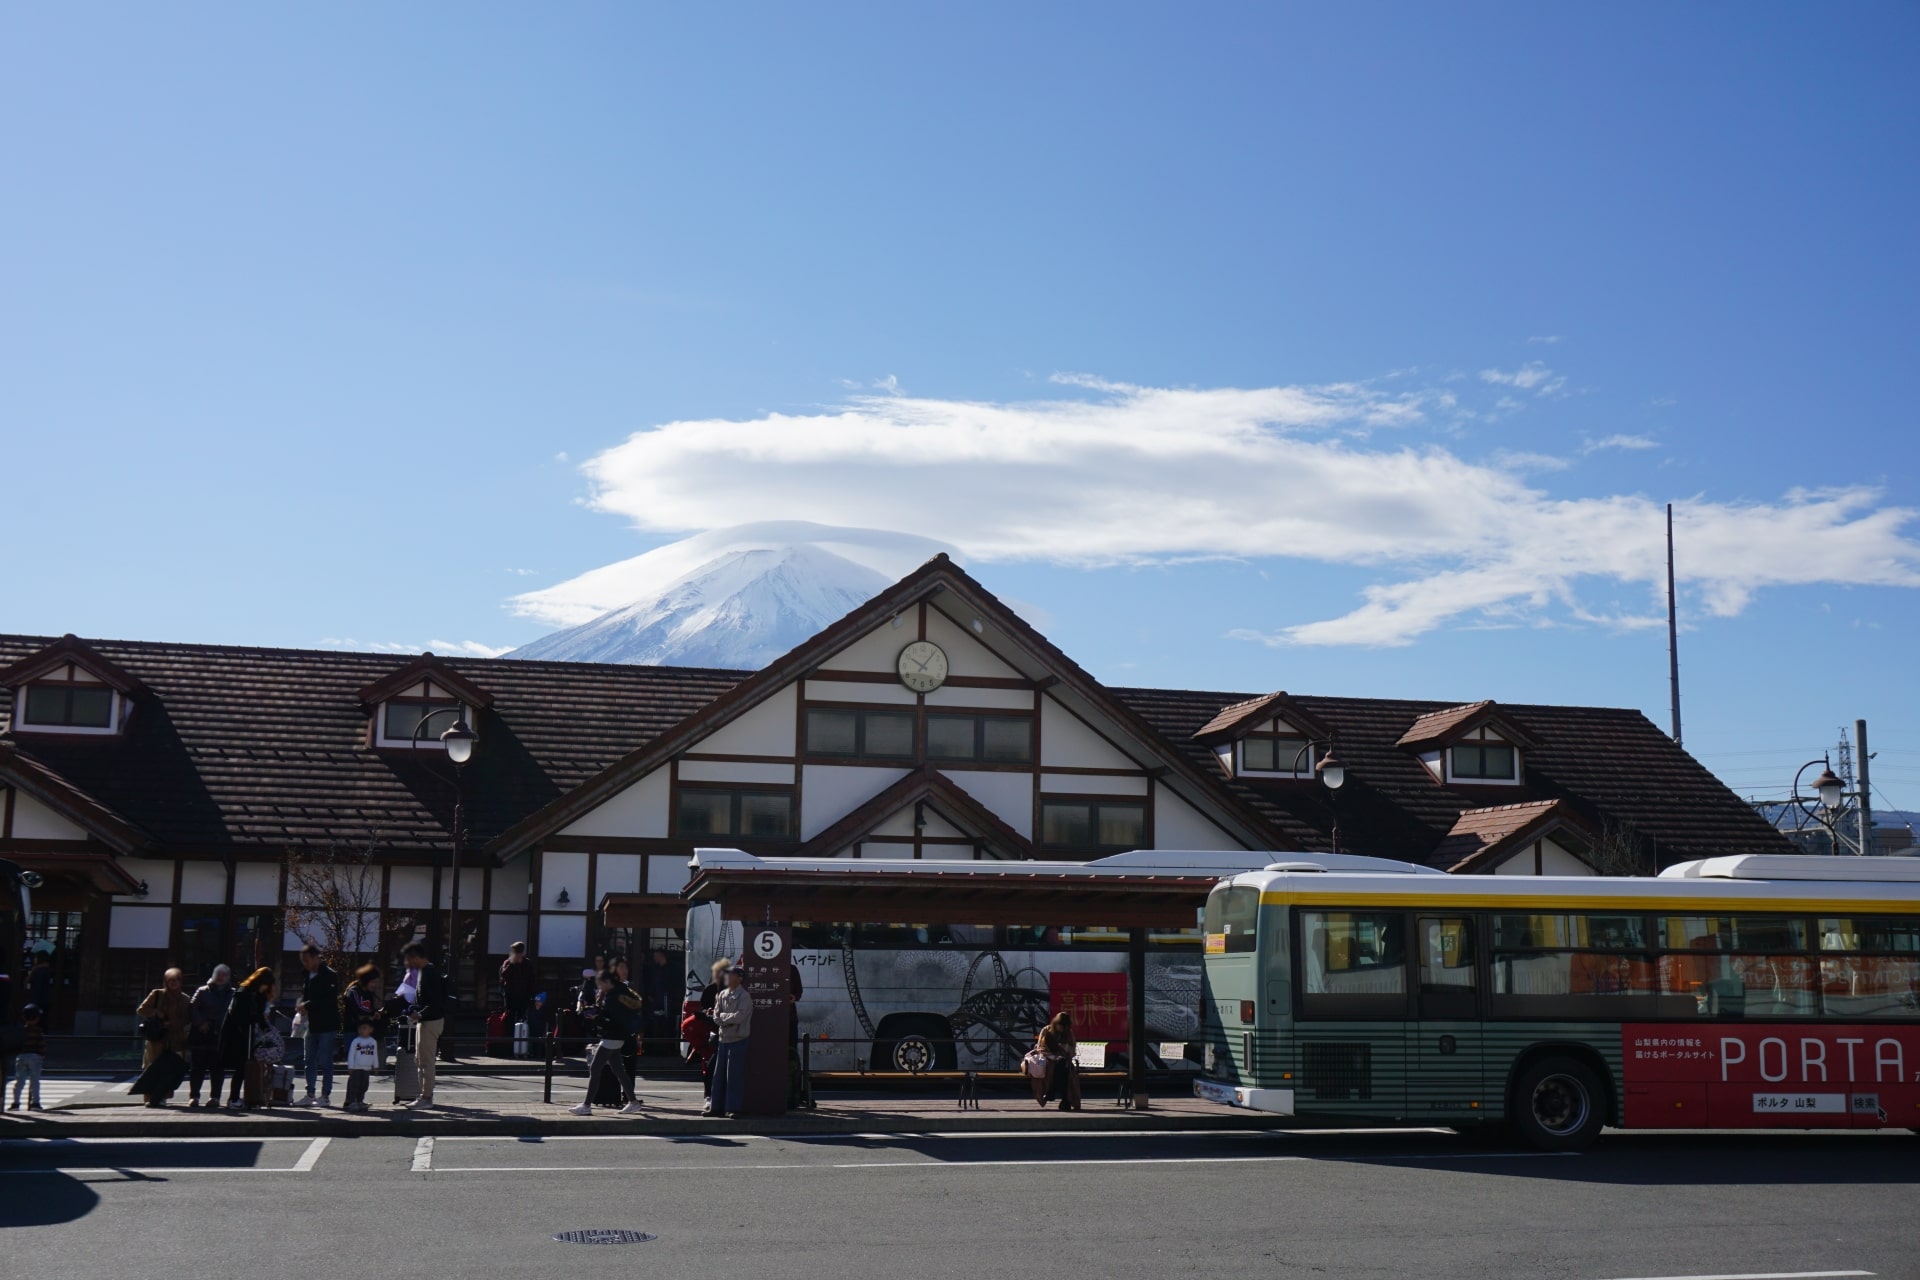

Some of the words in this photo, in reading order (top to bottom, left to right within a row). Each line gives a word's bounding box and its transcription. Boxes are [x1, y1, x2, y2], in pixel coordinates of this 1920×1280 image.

[761, 933, 774, 952] 5
[1060, 990, 1119, 1026] 高飛車
[1634, 1038, 1703, 1048] 山梨県内の情報を
[1635, 1050, 1716, 1060] 届けるポータルサイト
[1720, 1037, 1905, 1083] PORTA
[1757, 1097, 1789, 1109] ポルタ
[1794, 1097, 1816, 1109] 山梨
[1853, 1097, 1877, 1110] 検索
